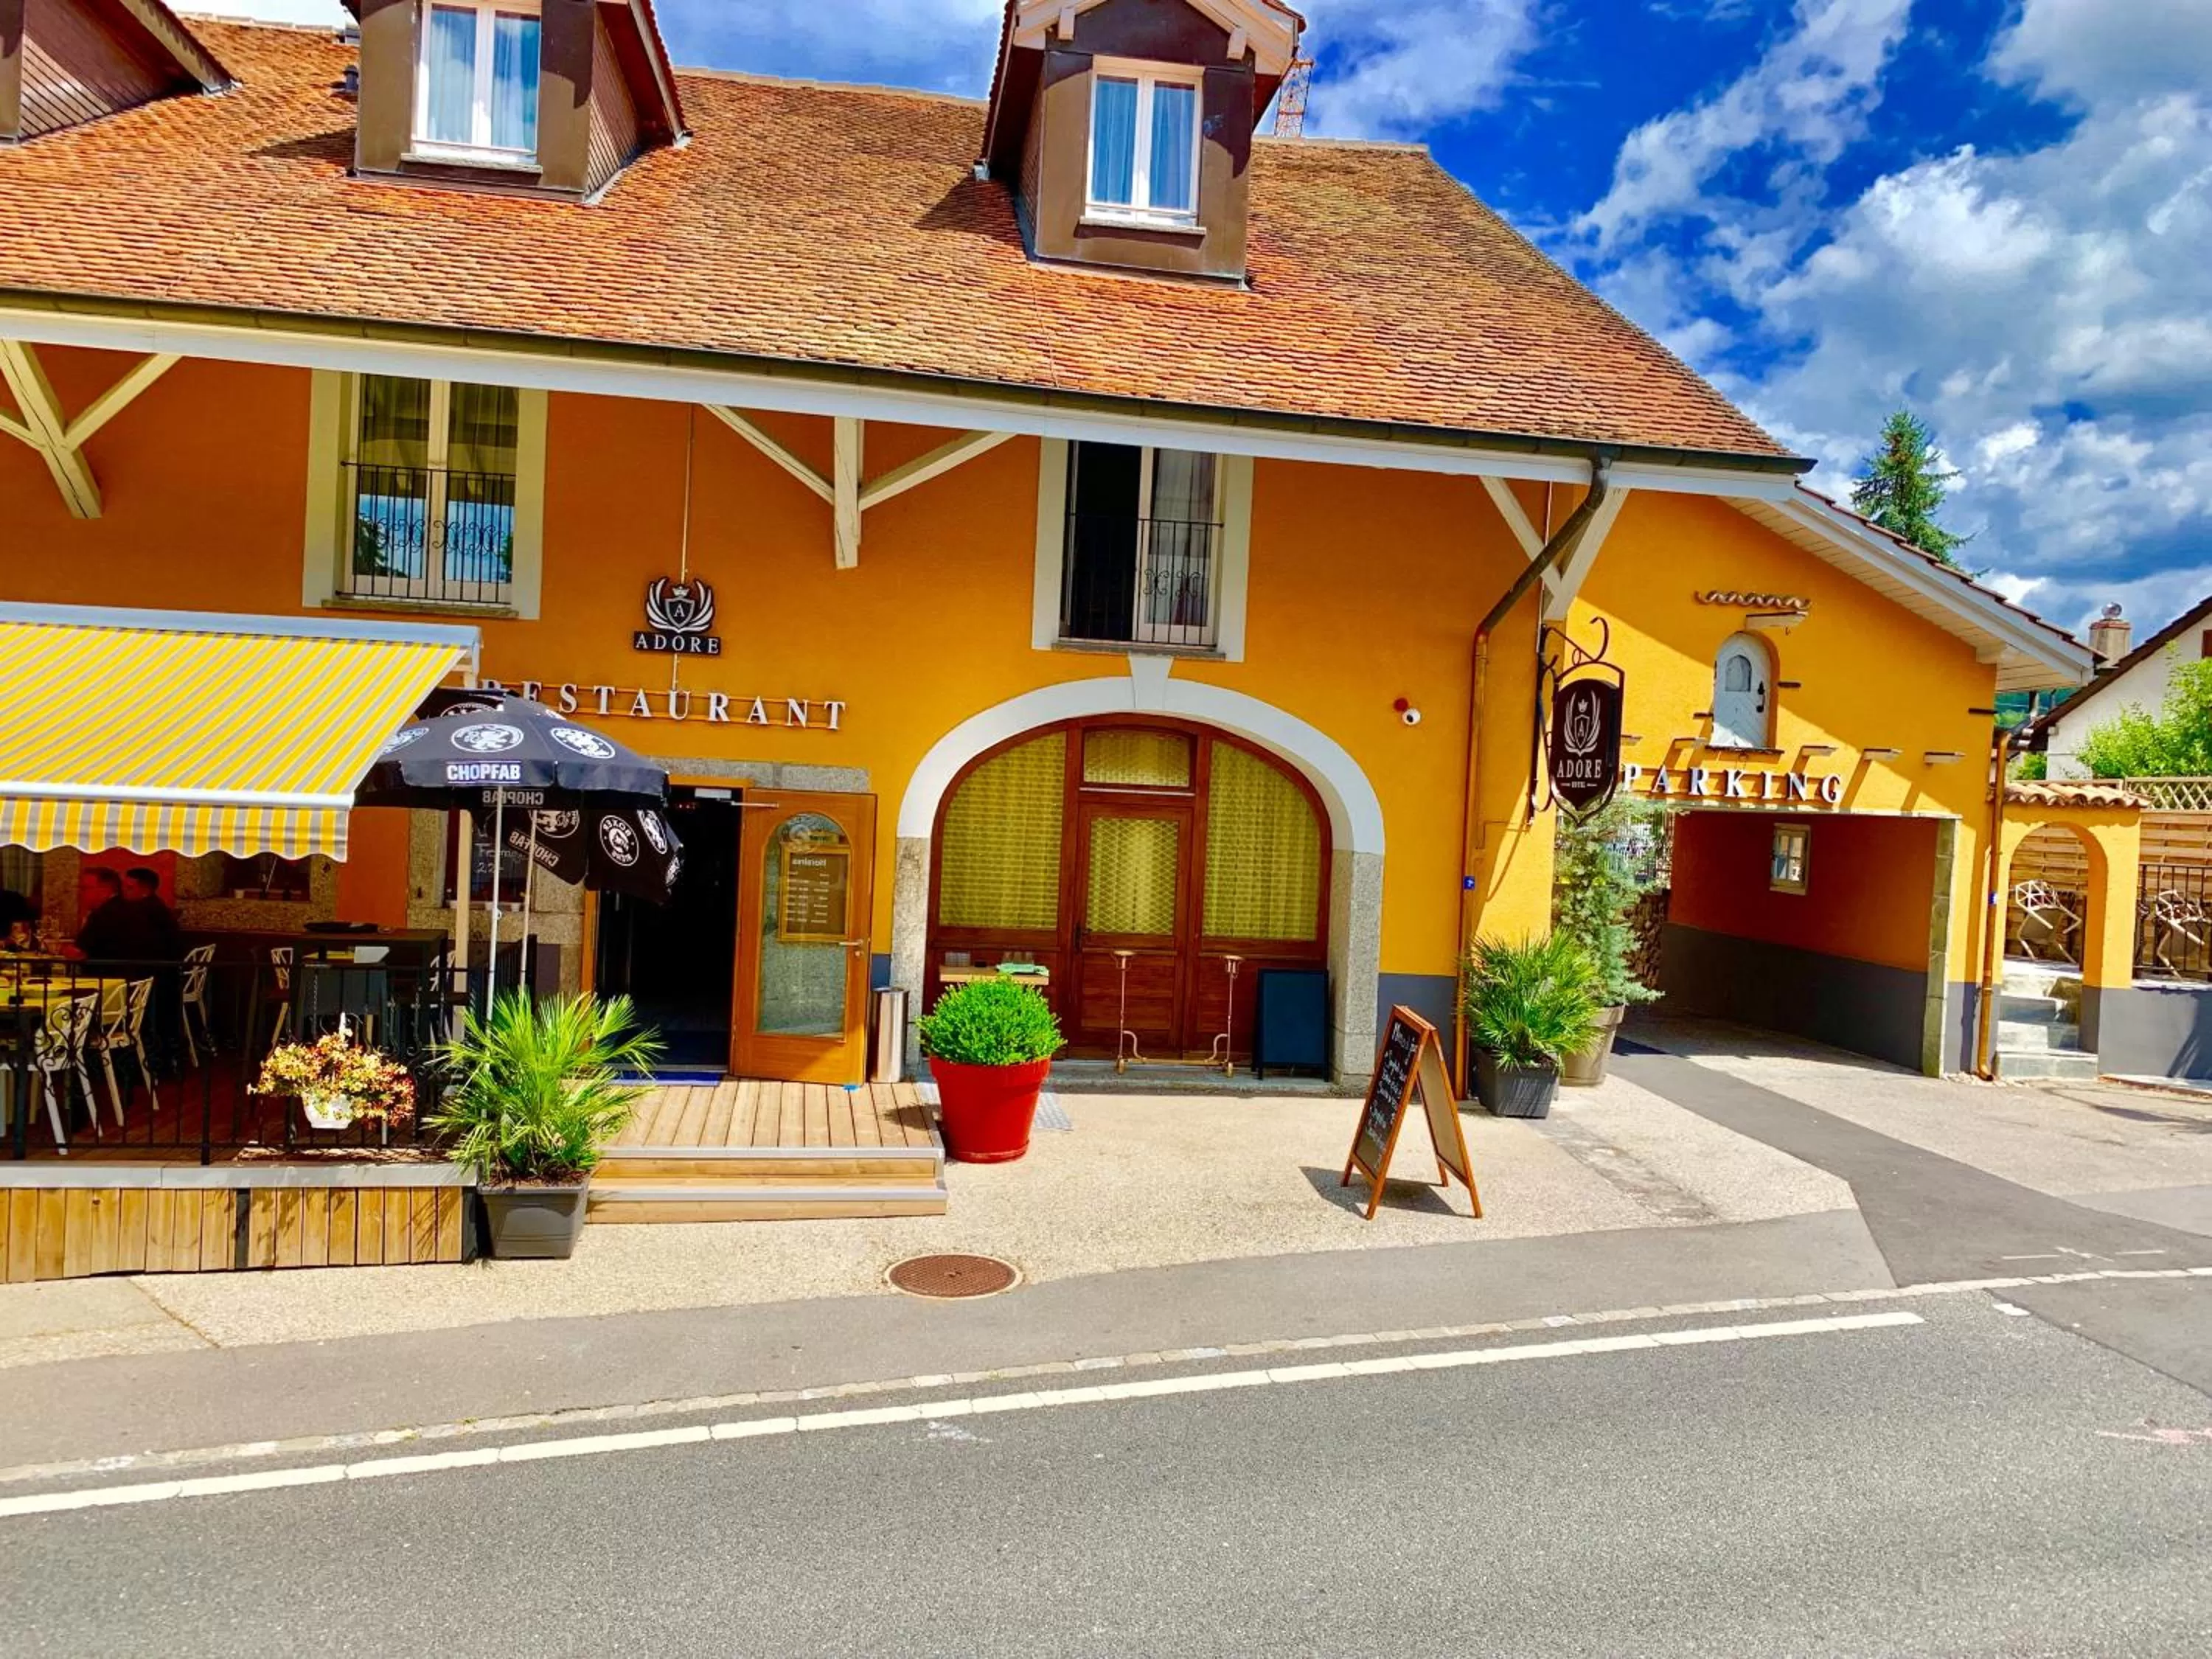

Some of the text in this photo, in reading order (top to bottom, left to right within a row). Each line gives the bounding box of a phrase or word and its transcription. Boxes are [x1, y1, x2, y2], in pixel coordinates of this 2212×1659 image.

[674, 604, 685, 617] A
[636, 633, 719, 654] ADORE
[446, 762, 521, 782] CHOPFAB
[1557, 759, 1602, 779] ADORE
[1622, 765, 1842, 803] PARKING
